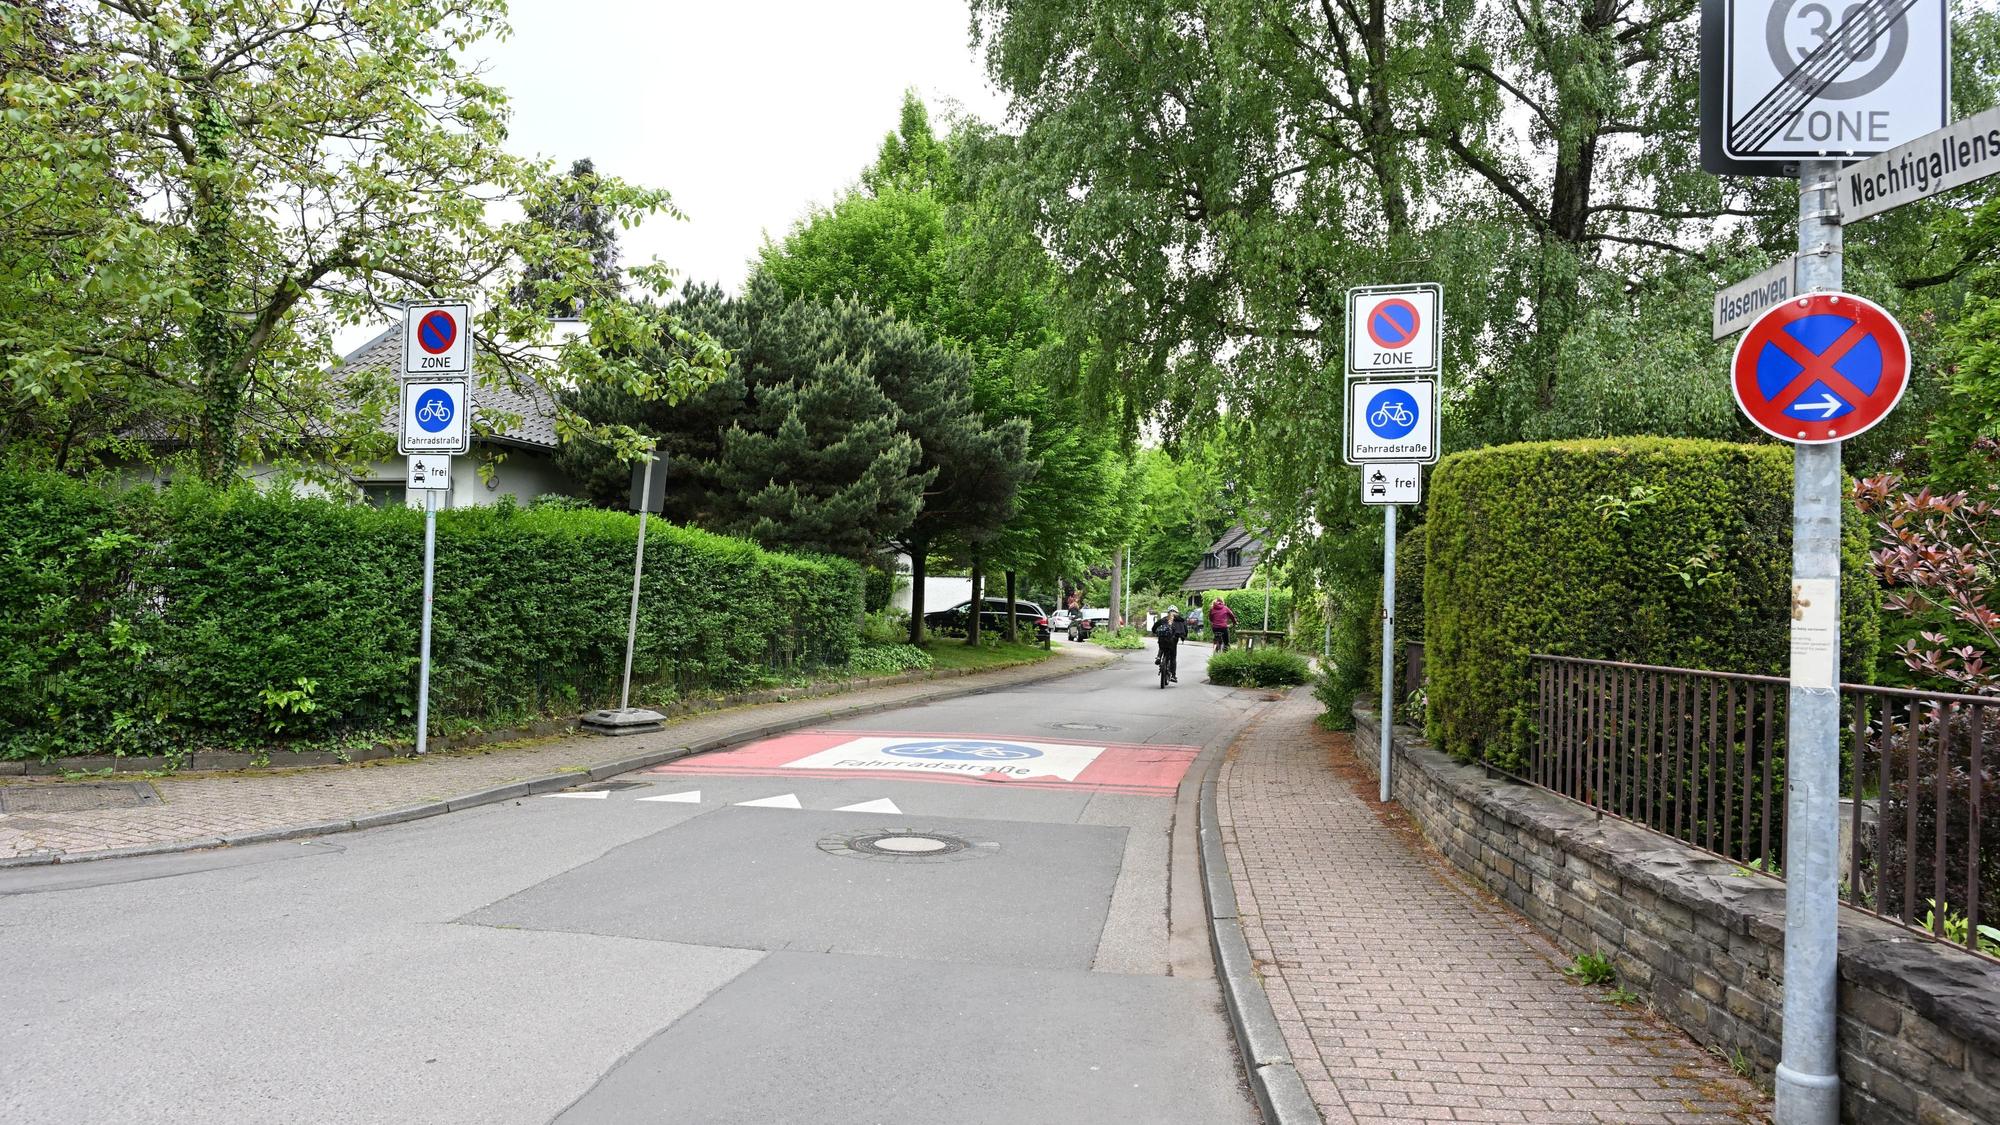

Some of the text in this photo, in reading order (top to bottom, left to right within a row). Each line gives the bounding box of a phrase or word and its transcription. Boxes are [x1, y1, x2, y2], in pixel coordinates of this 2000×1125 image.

[1796, 2, 1878, 62] 30
[1783, 111, 1890, 142] ZONE
[1851, 129, 2000, 207] Nachtigallens
[421, 357, 451, 368] ZONE
[1373, 352, 1413, 365] ZONE
[407, 436, 460, 445] Fahrradstraße
[1356, 444, 1427, 453] Fahrradstraße
[431, 467, 447, 476] frei
[1395, 478, 1416, 488] frei
[833, 759, 1031, 776] Fahrradstraße
